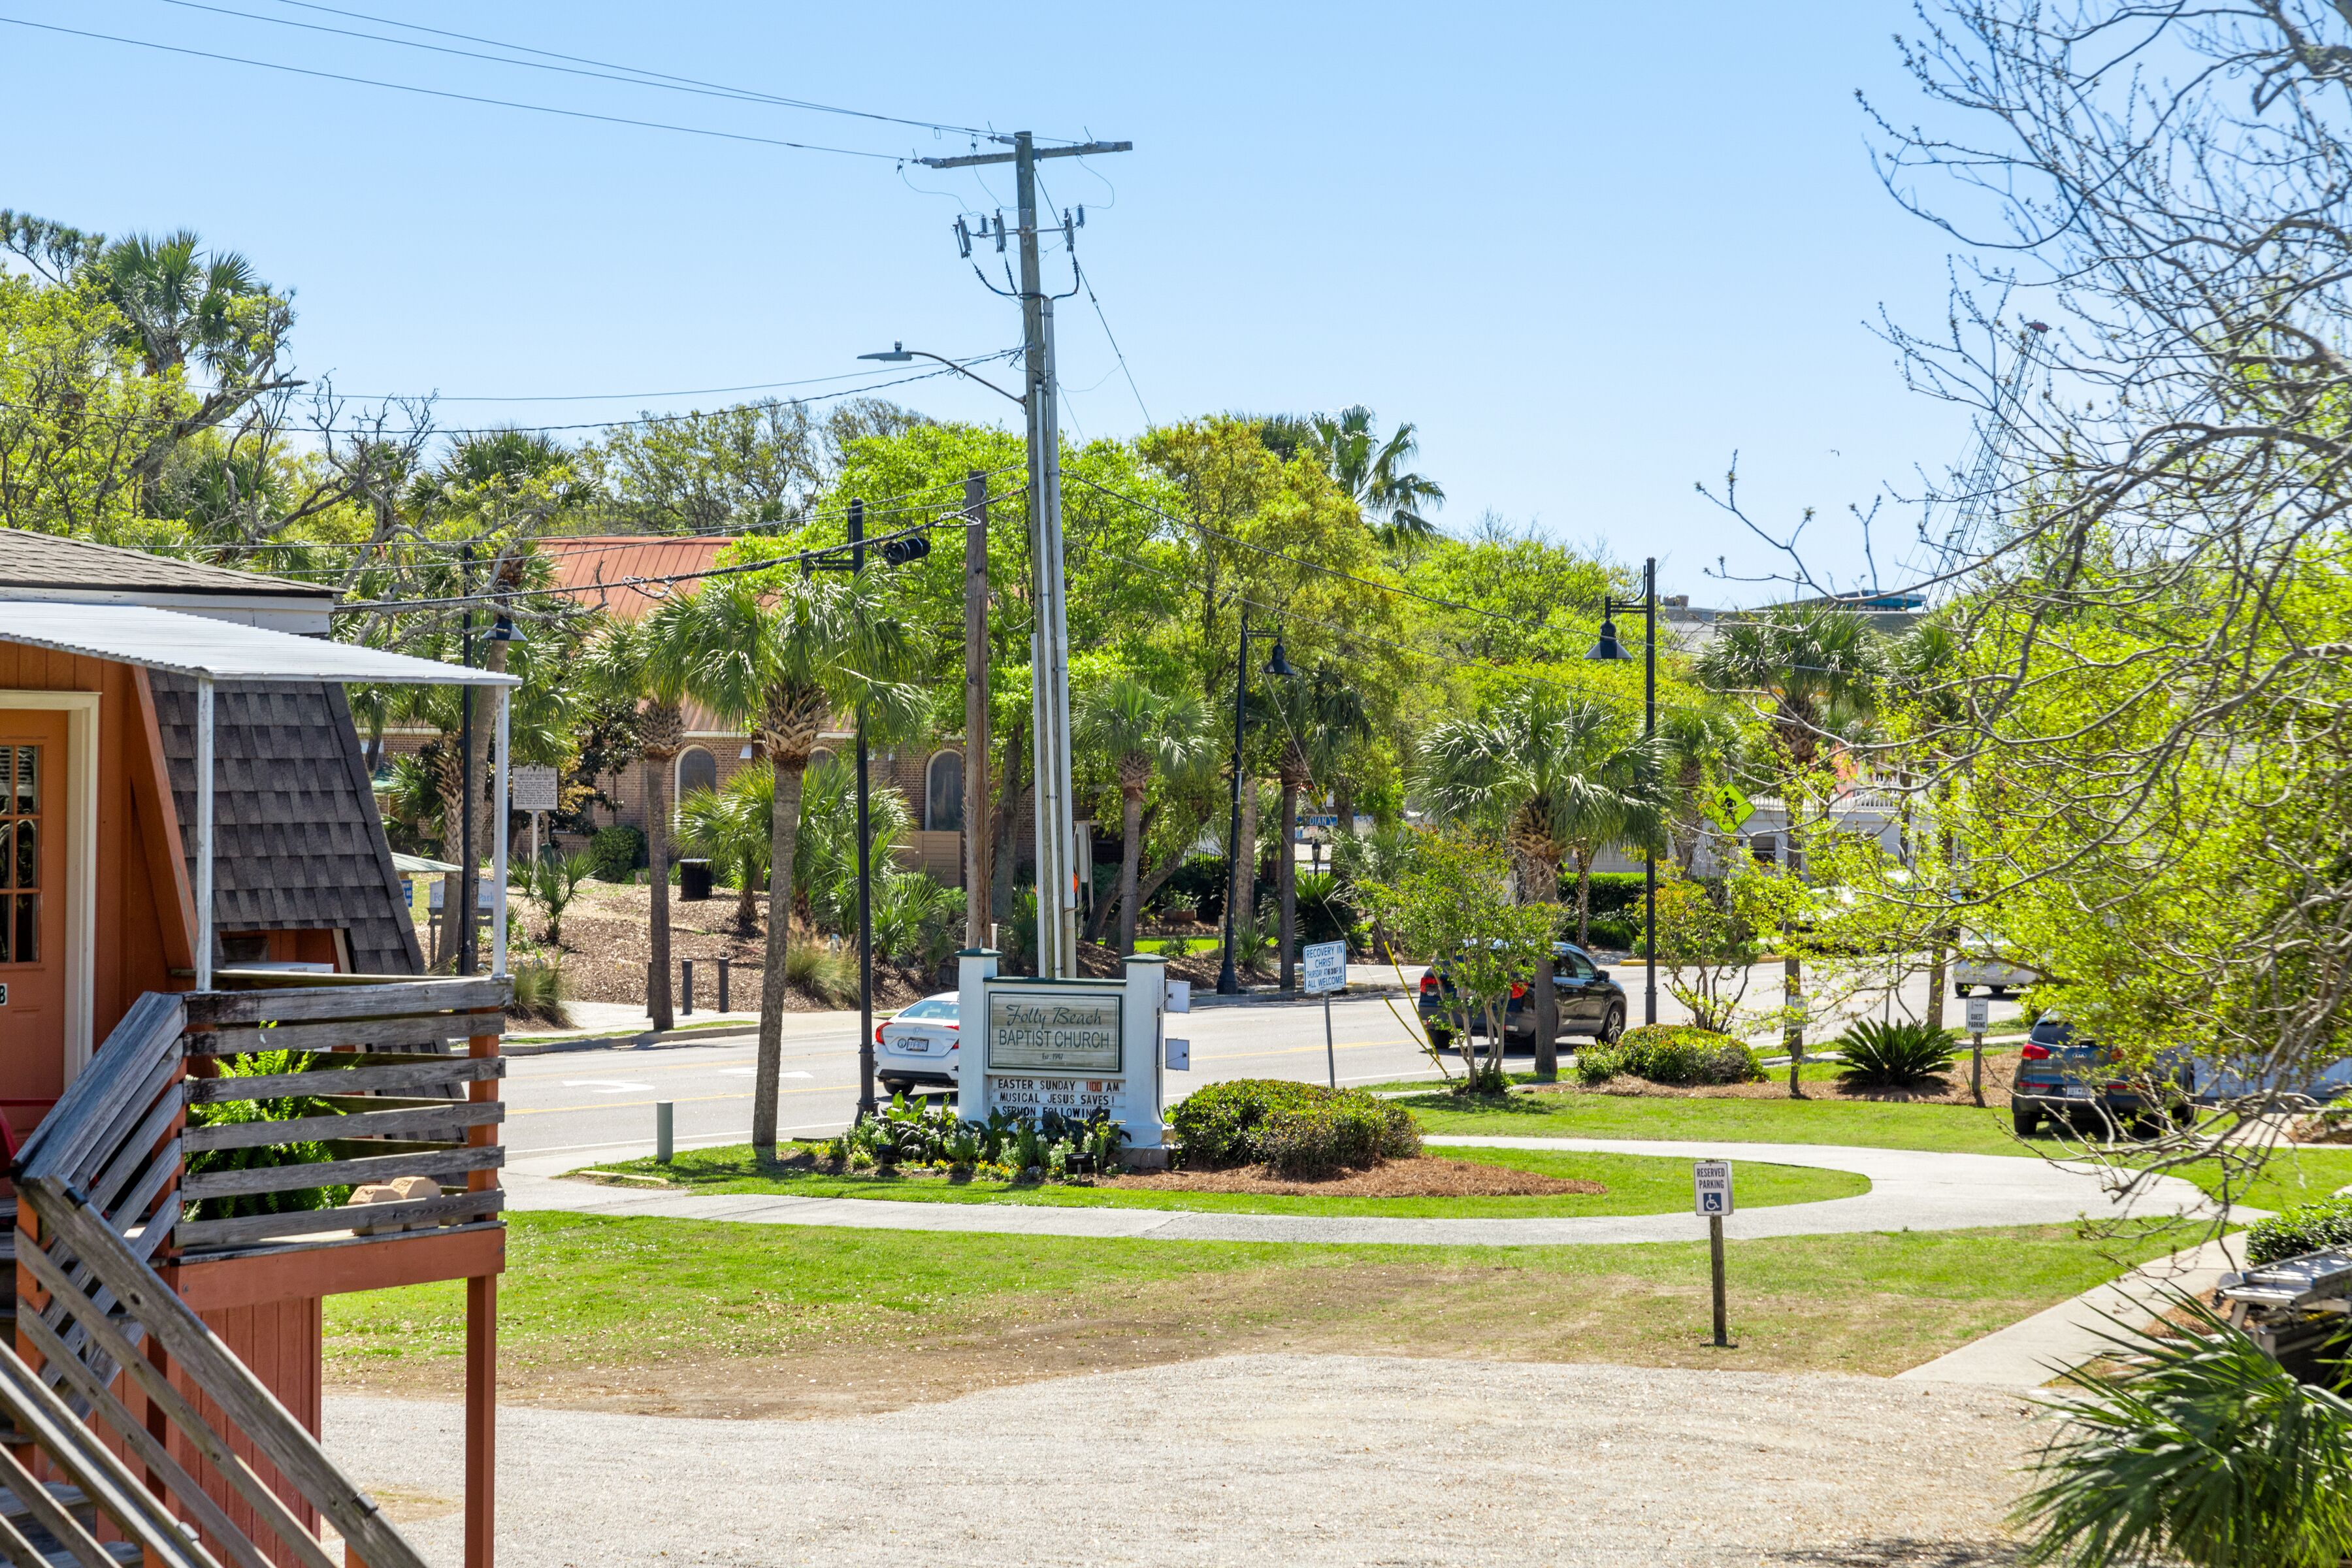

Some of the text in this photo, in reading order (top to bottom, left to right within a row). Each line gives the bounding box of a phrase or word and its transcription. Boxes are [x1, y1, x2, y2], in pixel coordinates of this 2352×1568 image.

[1306, 944, 1343, 959] RECOVERY IN
[1315, 956, 1334, 968] CHRIST
[1307, 968, 1323, 979] THURSDAY
[1307, 975, 1343, 988] ALL WELCOME
[1006, 1004, 1102, 1030] Folly Beach
[999, 1029, 1109, 1049] BAPTIST CHURCH
[998, 1079, 1034, 1090] EASTER
[1040, 1080, 1076, 1090] SUNDAY
[1106, 1082, 1120, 1092] AM
[1000, 1092, 1040, 1103] MUSICAL
[1047, 1094, 1075, 1104] JESUS
[1697, 1168, 1725, 1177] RESERVED
[1699, 1179, 1724, 1189] PARKING
